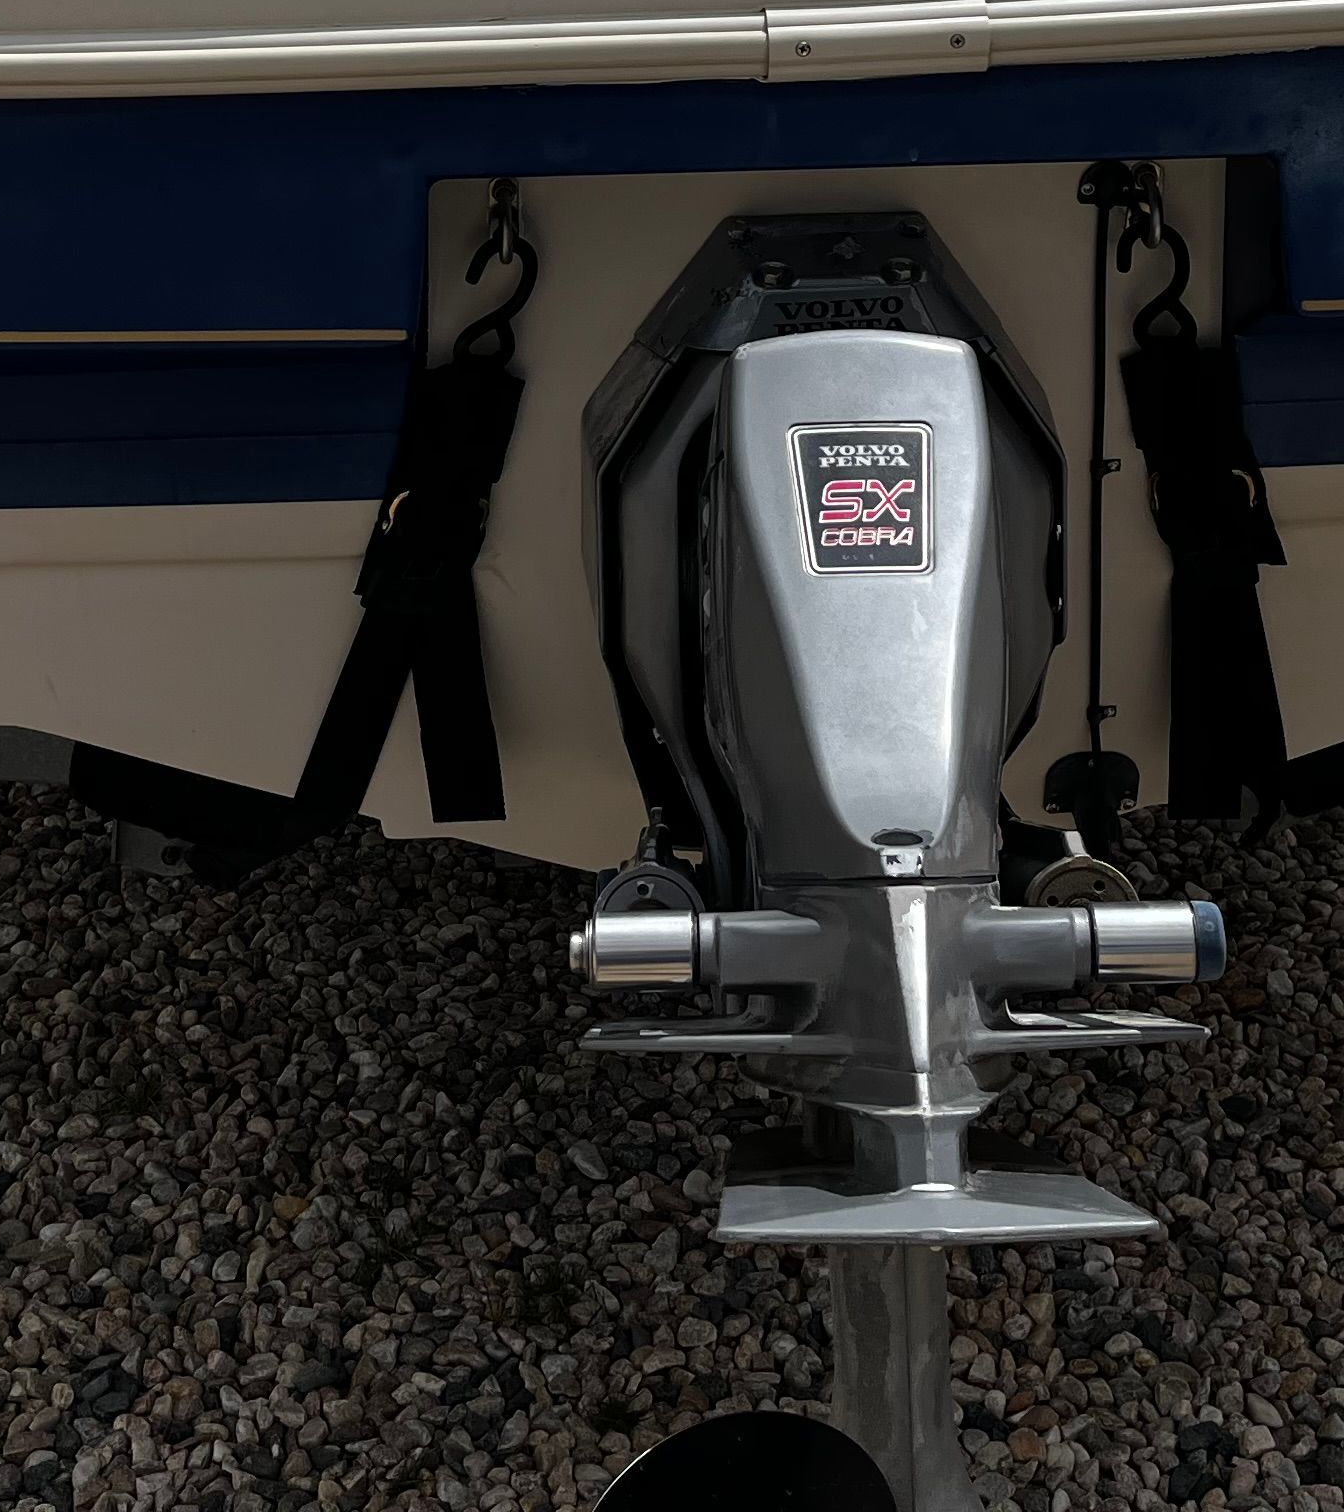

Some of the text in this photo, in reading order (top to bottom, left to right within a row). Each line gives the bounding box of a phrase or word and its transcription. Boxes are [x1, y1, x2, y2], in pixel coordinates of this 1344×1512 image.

[775, 295, 904, 321] VOLVO
[818, 444, 905, 456] VOLVO
[818, 455, 911, 468] PENTA
[818, 479, 916, 523] SX
[820, 527, 914, 546] COBRA
